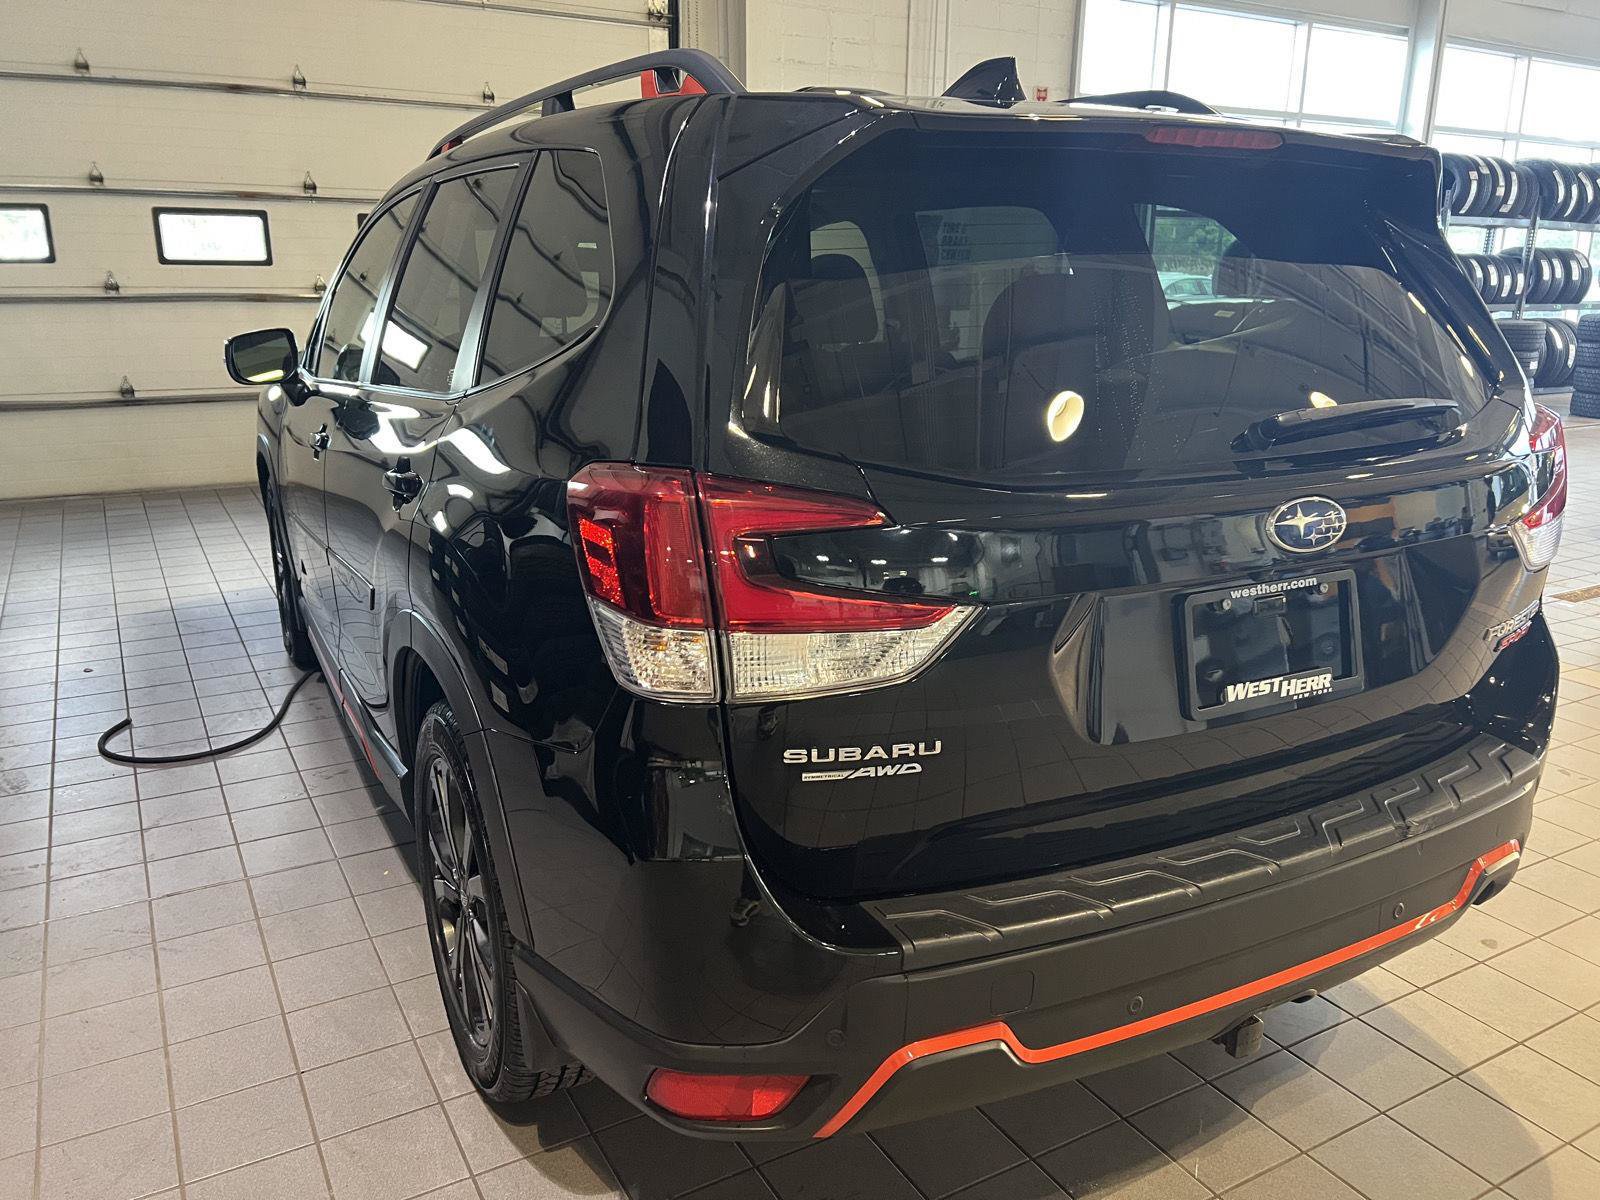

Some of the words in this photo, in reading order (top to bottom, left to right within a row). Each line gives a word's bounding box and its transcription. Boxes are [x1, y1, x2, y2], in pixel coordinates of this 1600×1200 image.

[1230, 576, 1318, 599] westherr.com
[783, 740, 942, 764] SUBARU
[847, 762, 923, 779] AWD
